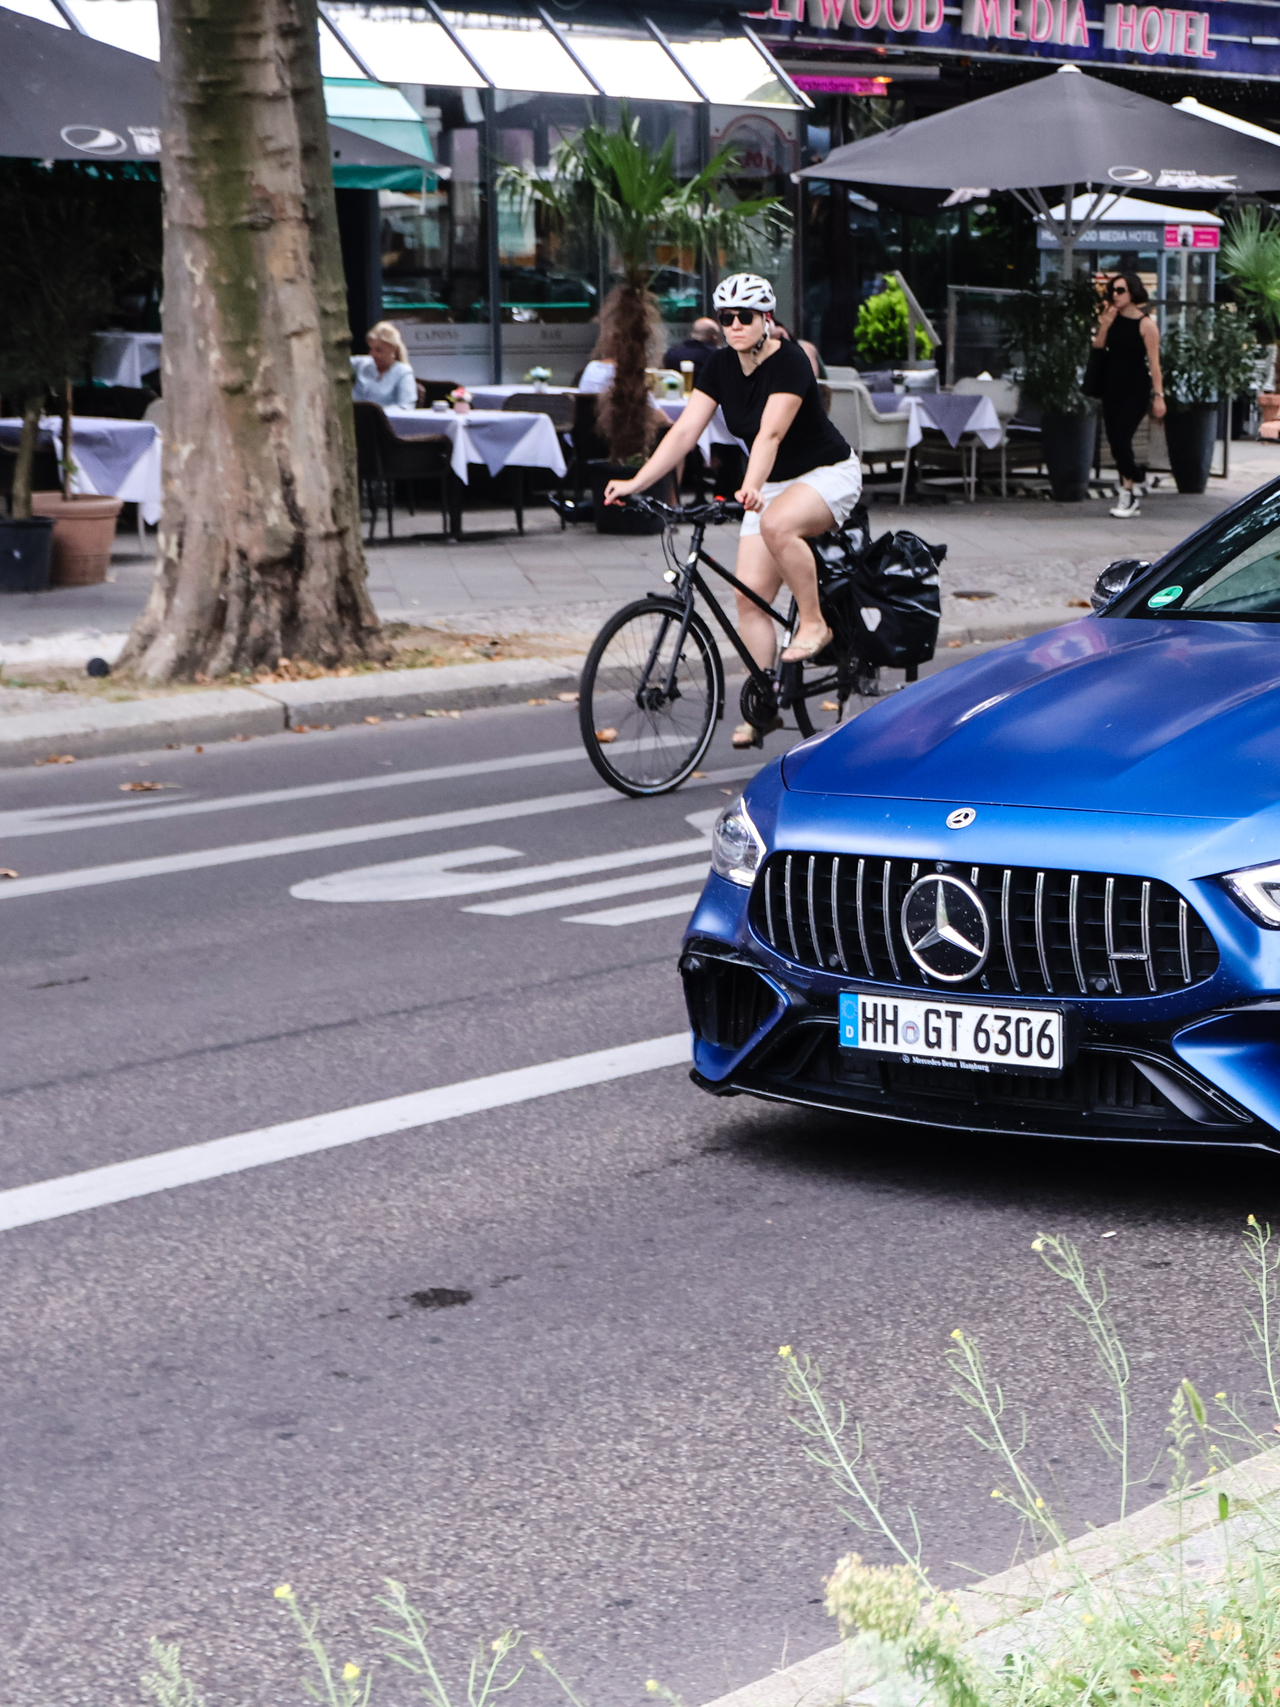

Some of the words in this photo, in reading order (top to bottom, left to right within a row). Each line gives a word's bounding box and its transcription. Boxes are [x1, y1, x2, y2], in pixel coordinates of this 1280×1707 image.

[973, 0, 1089, 47] MEDIA
[1116, 3, 1217, 58] HOTEL
[1155, 174, 1238, 190] MAX
[1099, 230, 1127, 243] MEDIA
[1128, 230, 1159, 243] HOTEL
[845, 1025, 855, 1038] D
[861, 1001, 899, 1045] HH
[924, 1008, 963, 1051] GT
[973, 1013, 1055, 1060] 6306
